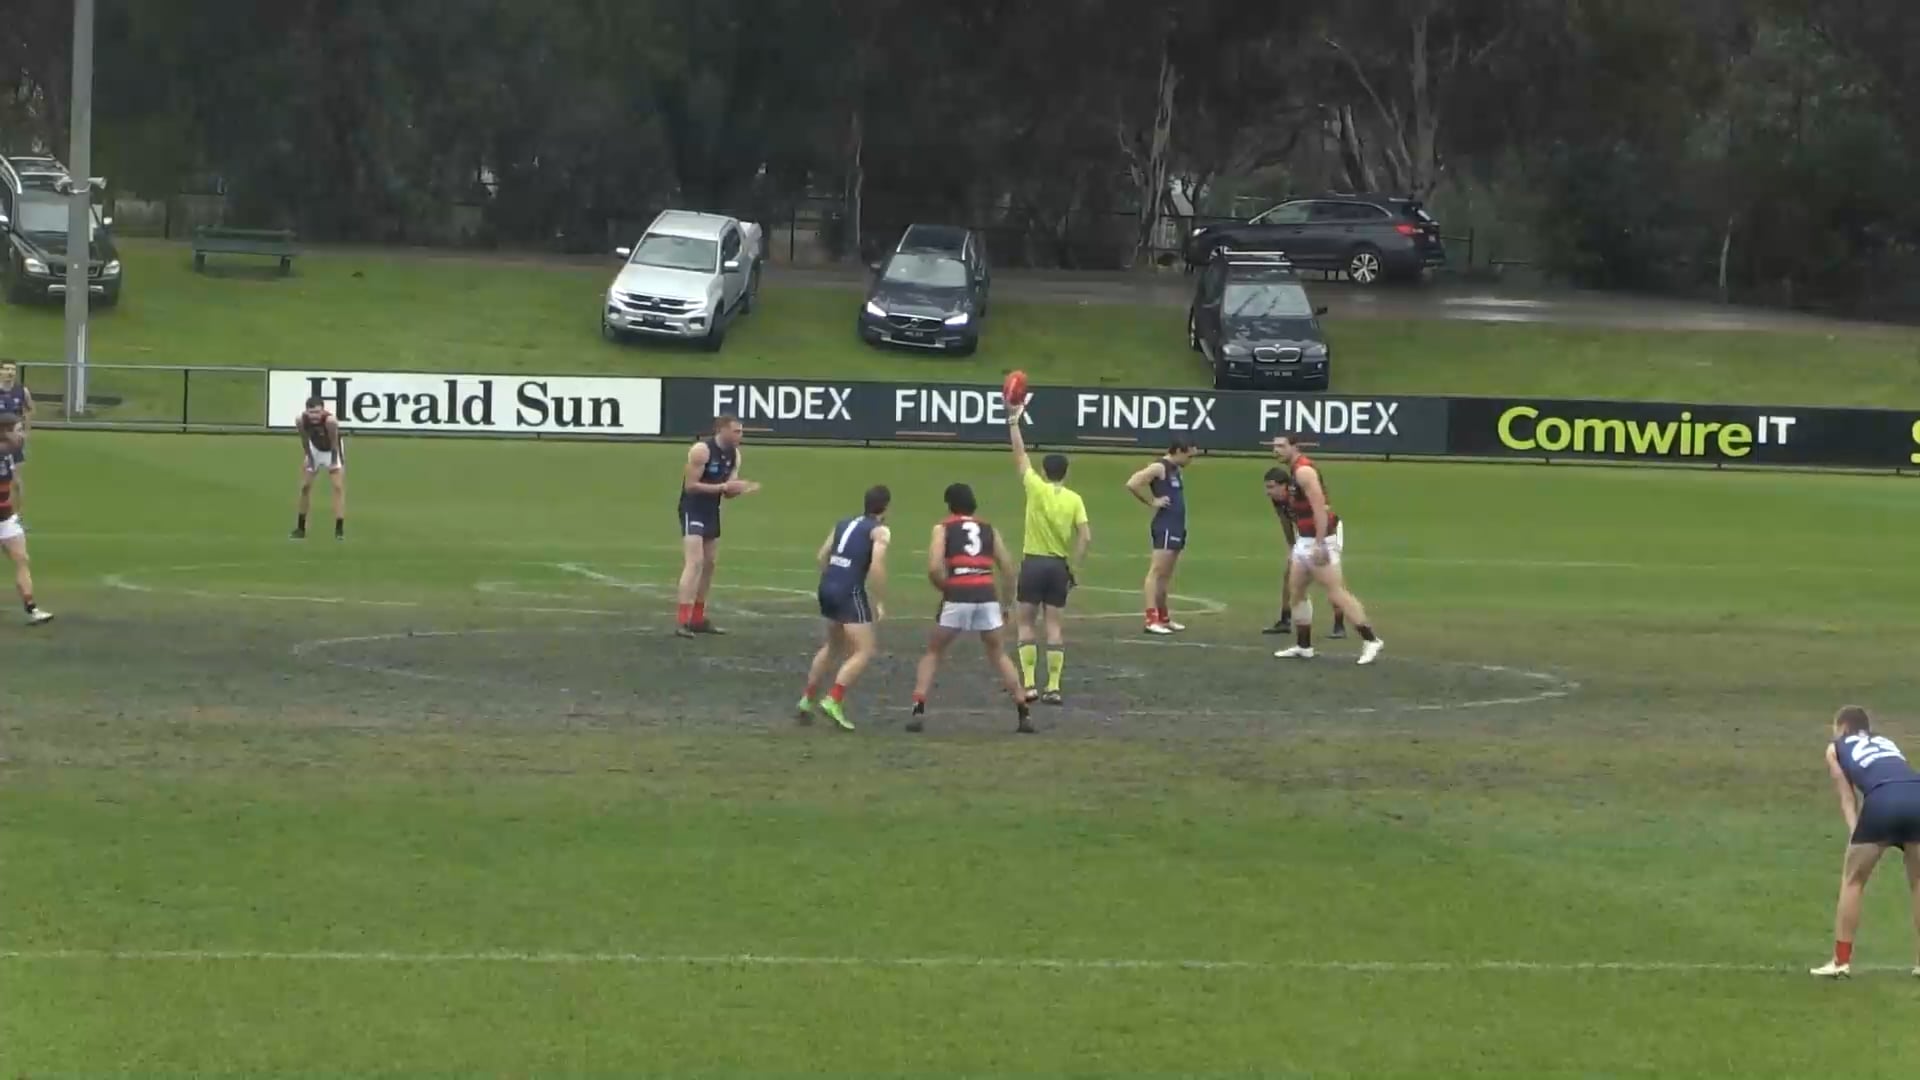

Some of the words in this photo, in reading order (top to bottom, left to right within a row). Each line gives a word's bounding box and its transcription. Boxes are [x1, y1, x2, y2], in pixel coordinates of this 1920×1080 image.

[306, 377, 495, 425] Herald
[516, 381, 624, 428] Sun
[713, 384, 852, 420] FINDEX
[1077, 393, 1216, 431] FINDEX
[1259, 398, 1399, 436] FINDEX
[837, 519, 859, 554] 1
[961, 521, 983, 556] 3
